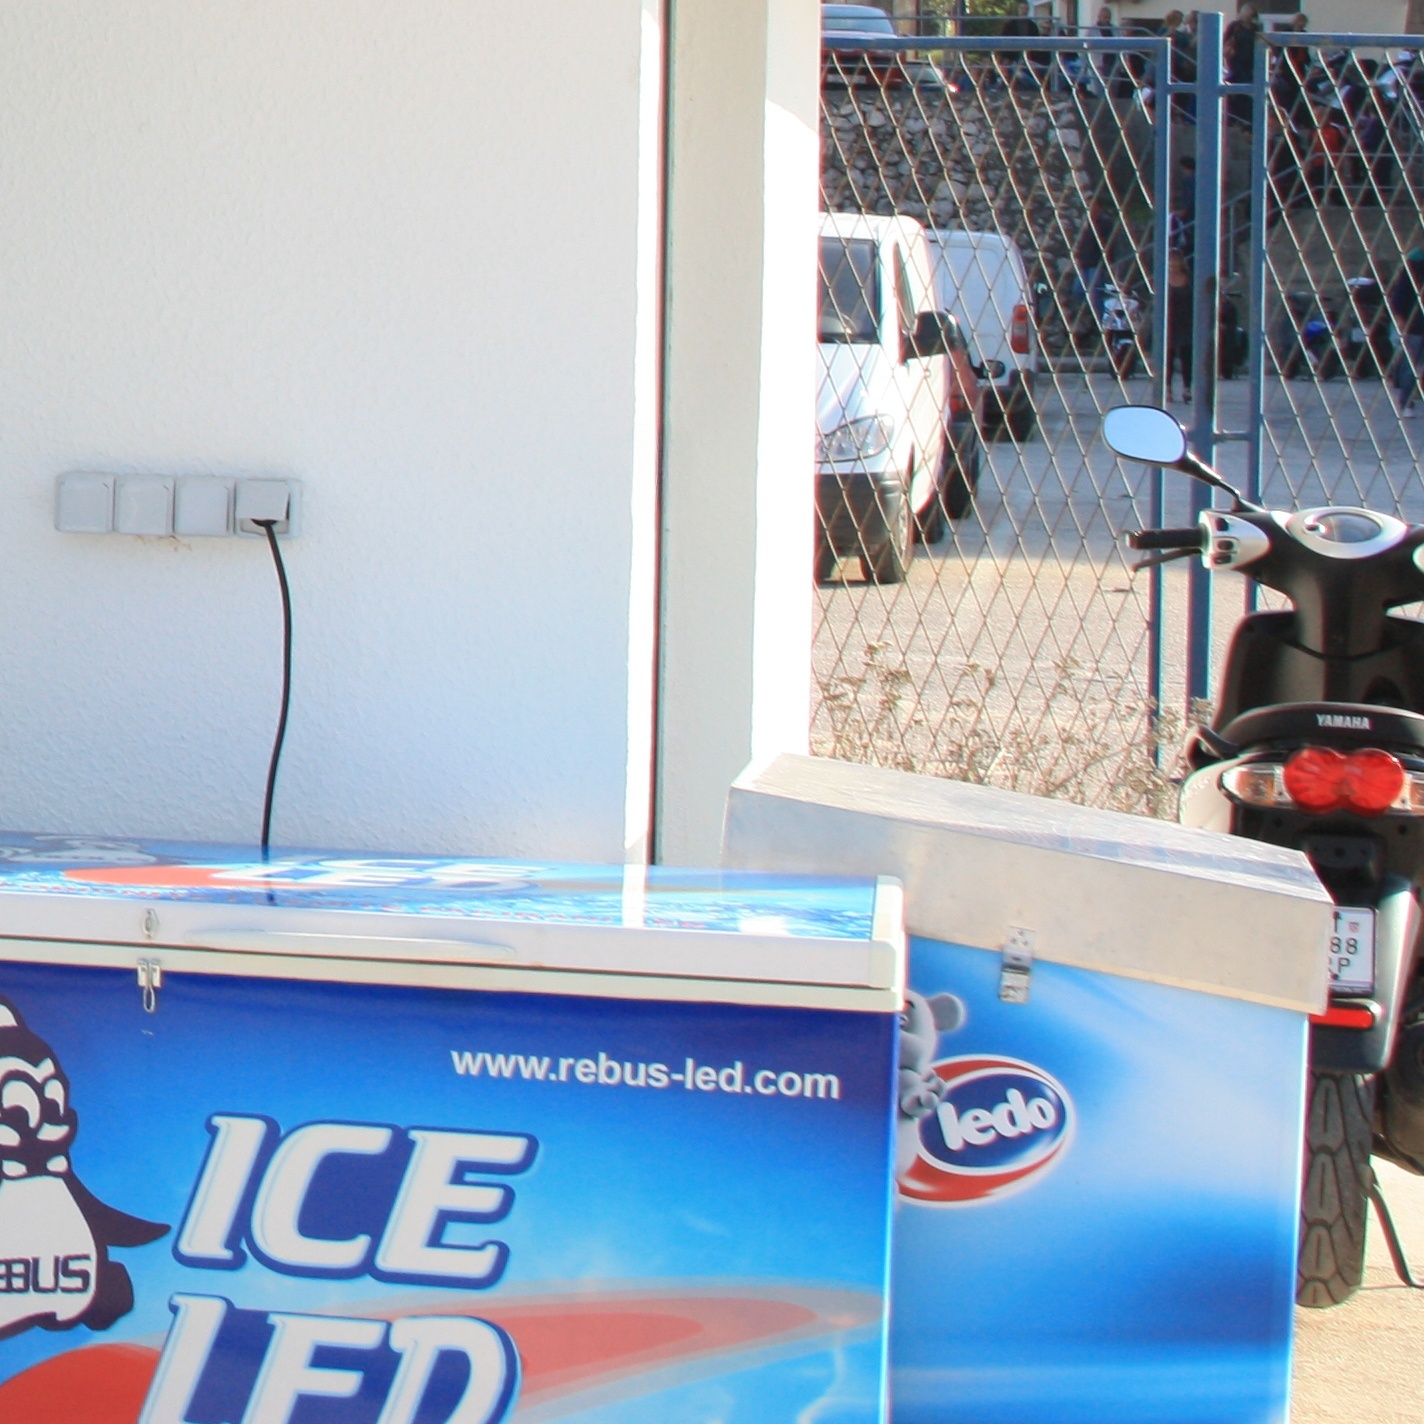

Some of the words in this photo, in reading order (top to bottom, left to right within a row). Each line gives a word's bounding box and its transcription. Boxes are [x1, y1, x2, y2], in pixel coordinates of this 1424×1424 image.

[1316, 713, 1370, 730] YAMAHA
[451, 1049, 841, 1100] www.rebus-led.com
[174, 1113, 537, 1284] ICE
